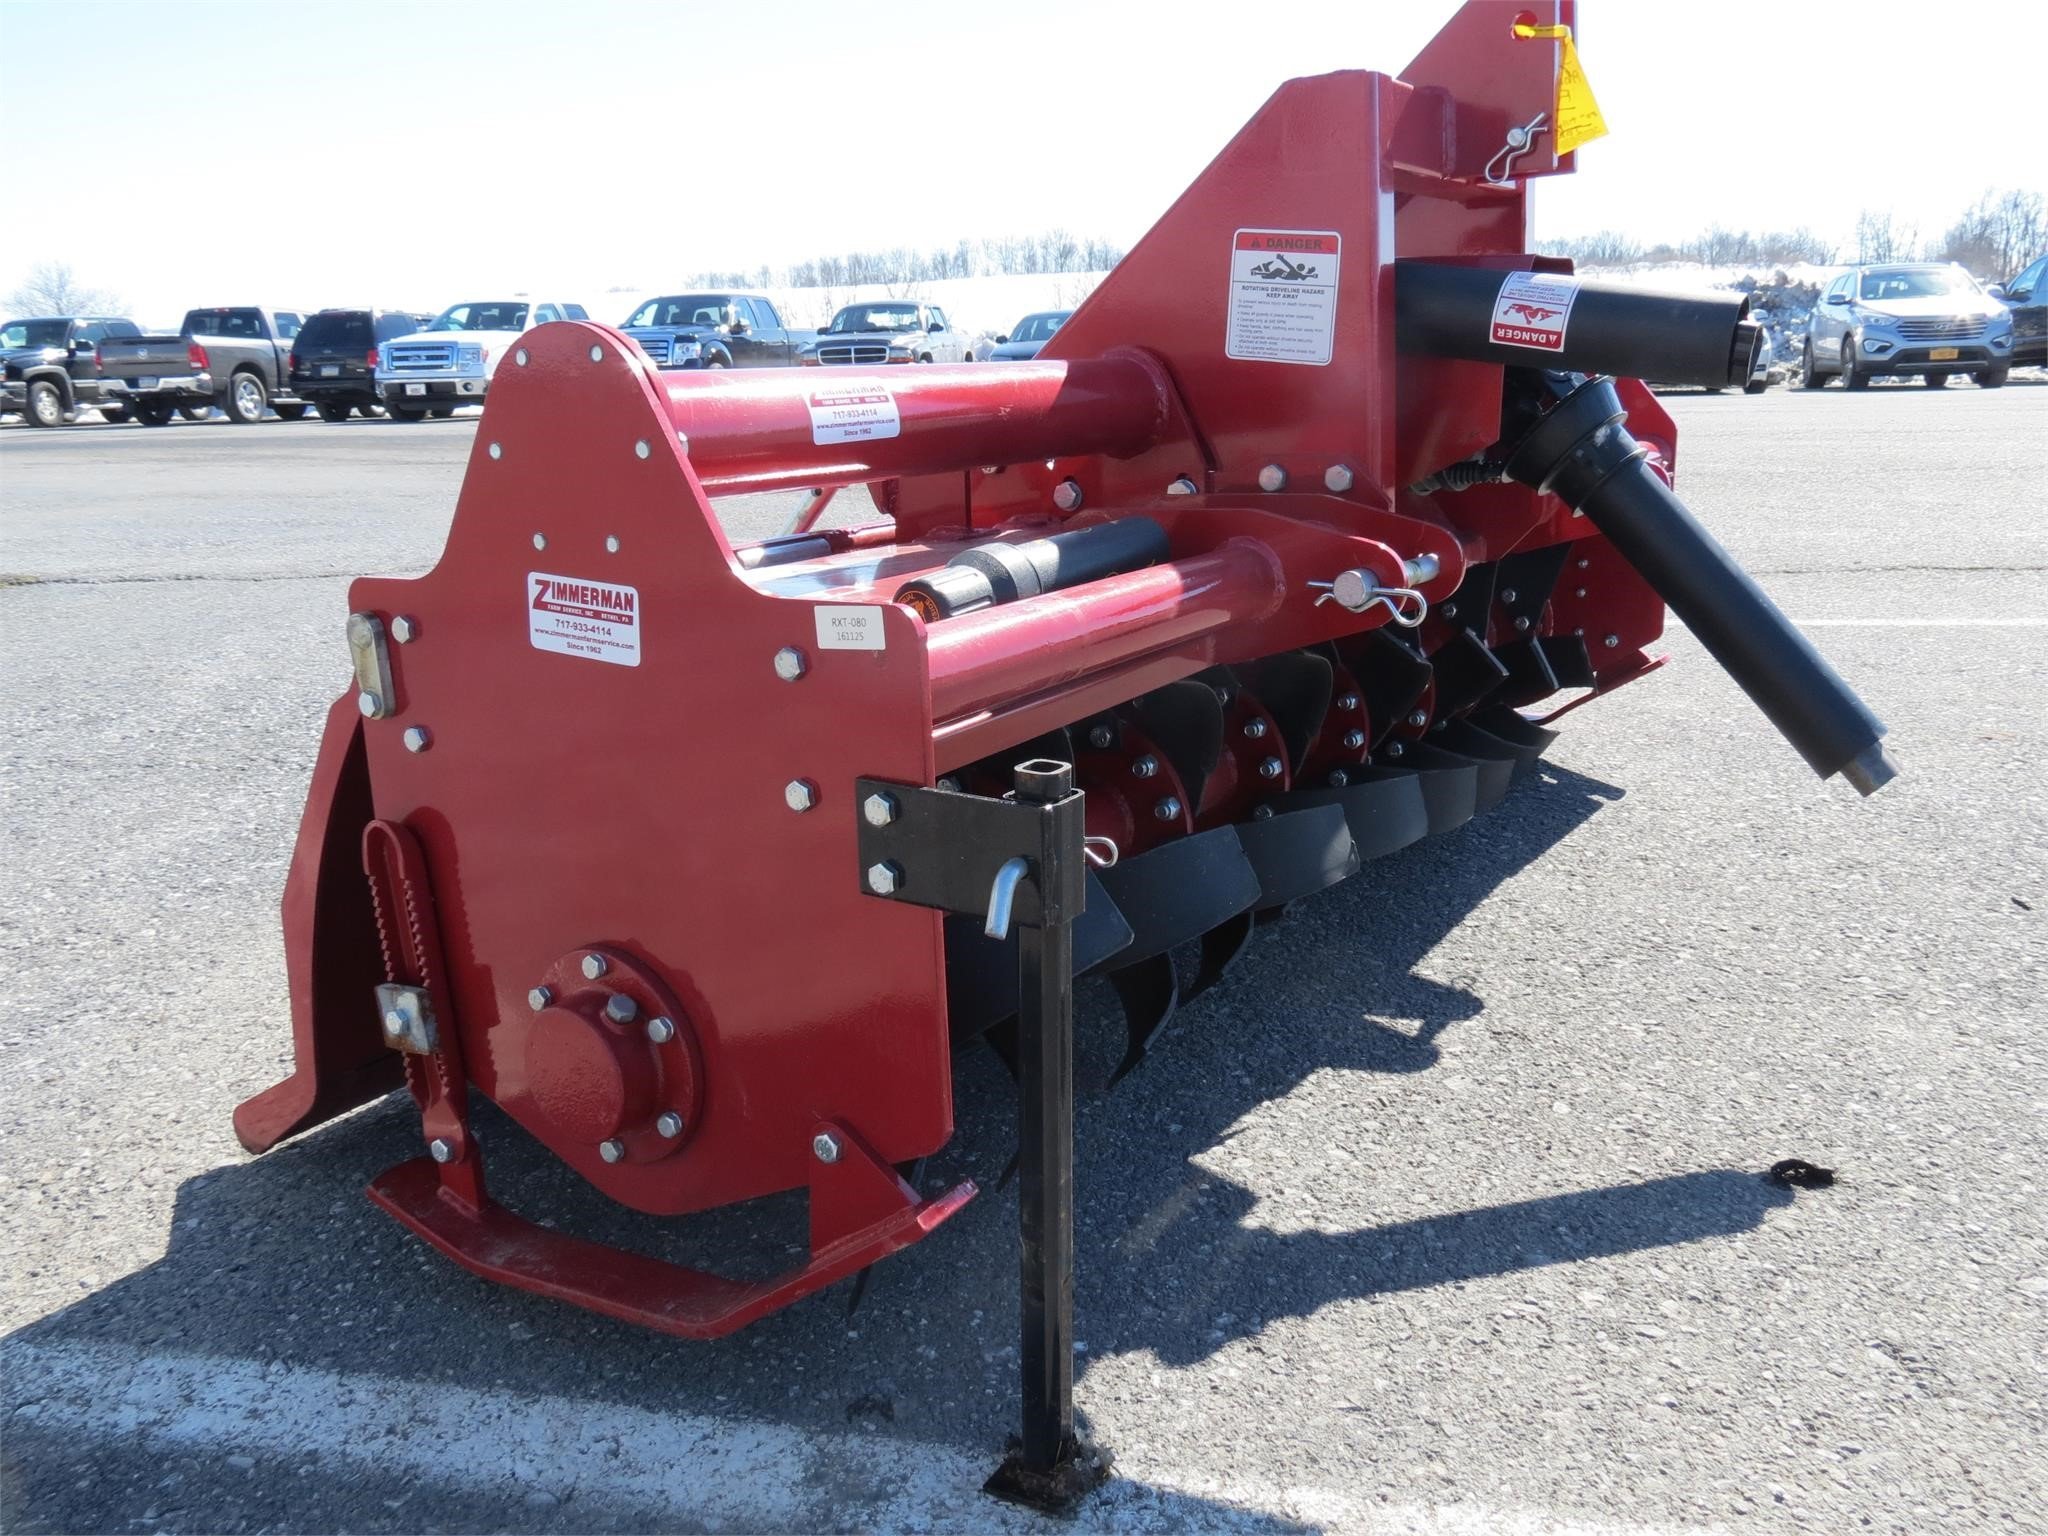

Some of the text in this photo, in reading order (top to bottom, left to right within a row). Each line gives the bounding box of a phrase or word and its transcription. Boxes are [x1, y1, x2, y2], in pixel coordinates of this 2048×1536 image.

[1267, 239, 1322, 249] DANGER
[1497, 328, 1547, 343] DANGER
[832, 408, 877, 419] 717-933-4114
[533, 579, 634, 613] ZIMMERMAN
[555, 619, 612, 636] 717-933-4114
[832, 617, 867, 627] RXT-080
[534, 628, 635, 650] www.zimmermanfarmservice.com
[566, 641, 602, 654] Since 1962
